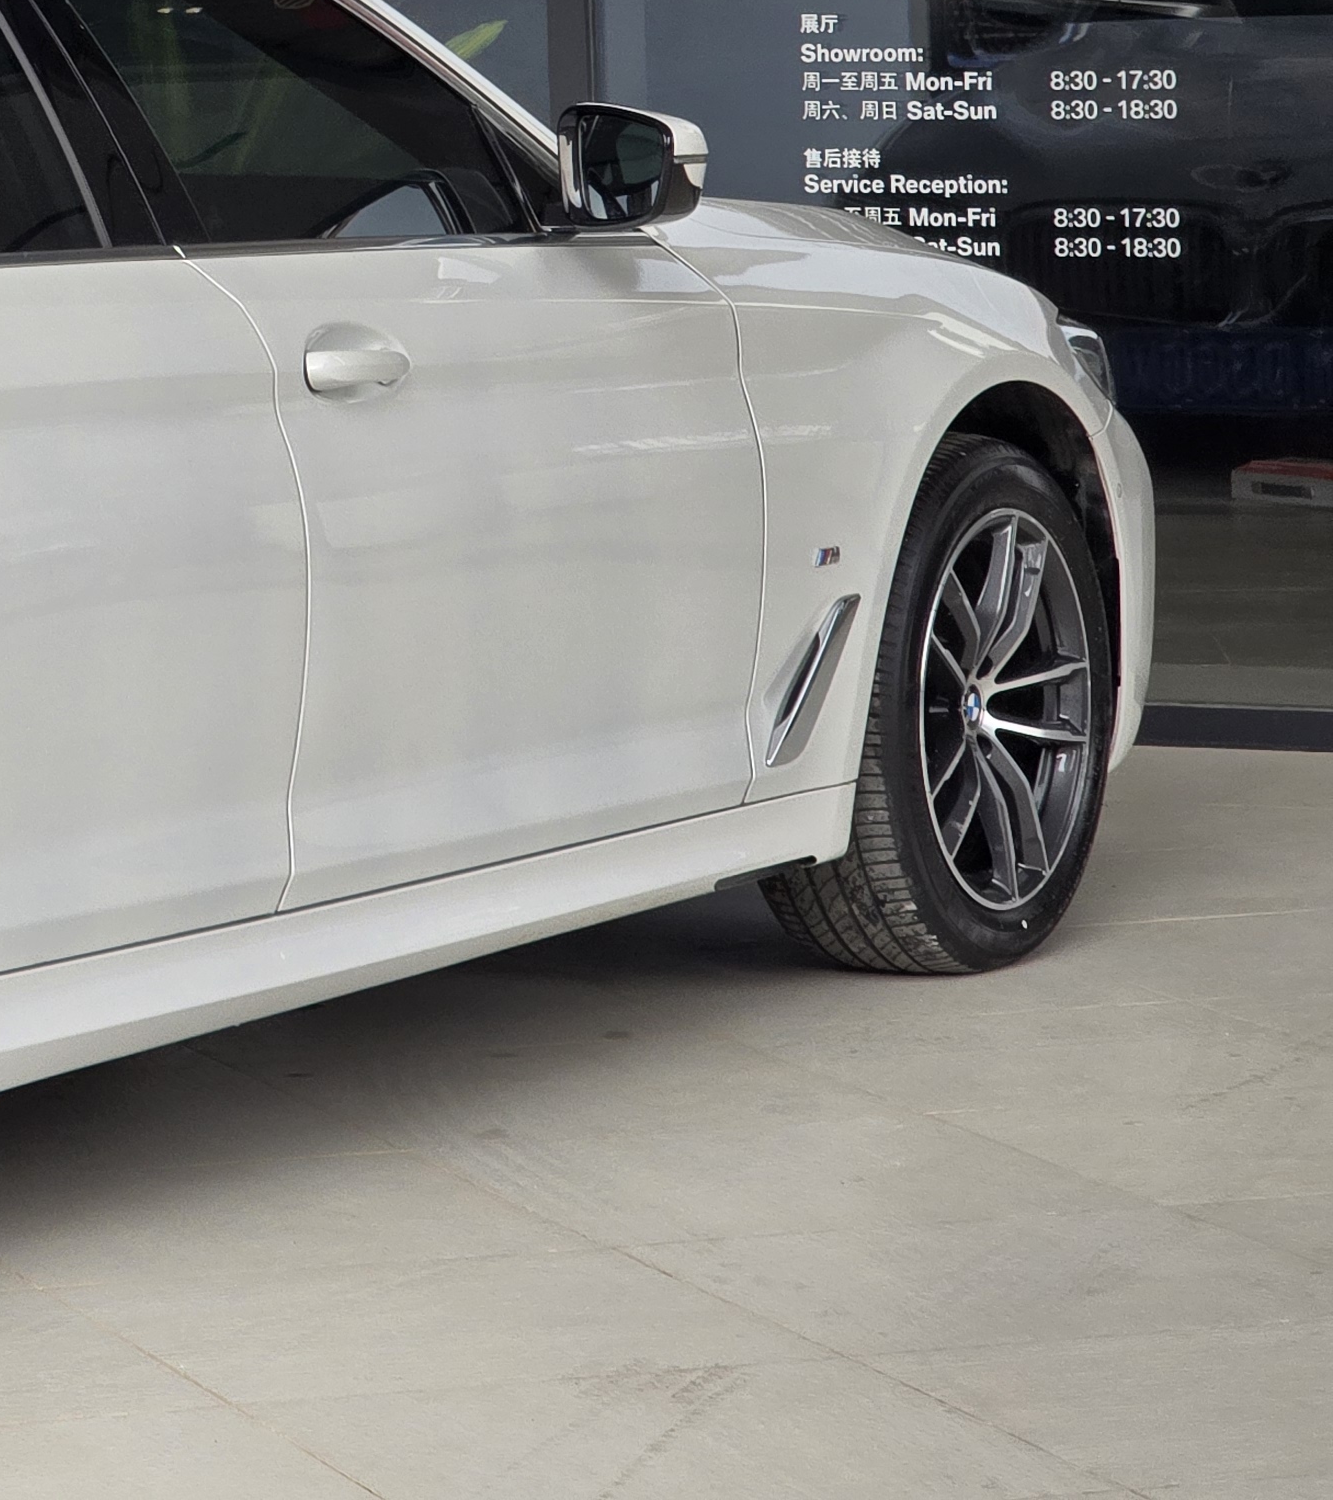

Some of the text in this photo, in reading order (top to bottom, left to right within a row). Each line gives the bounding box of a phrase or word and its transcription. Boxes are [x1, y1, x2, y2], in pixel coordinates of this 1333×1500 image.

[799, 13, 839, 34] 展厅
[800, 43, 924, 64] Showroom:
[801, 71, 899, 92] 周一至周五
[905, 71, 993, 92] Mon-Fri
[1050, 70, 1098, 91] 8:30
[1116, 69, 1177, 90] 17:30
[906, 100, 997, 121] Sat-Sun
[1050, 99, 1098, 120] 8:30
[1117, 99, 1178, 120] 18:30
[803, 147, 881, 169] 售后接待
[804, 173, 1008, 198] Service Reception:
[908, 207, 996, 227] Mon-Fri
[1053, 207, 1101, 228] 8:30
[1120, 207, 1180, 228] 17:30
[1054, 237, 1102, 258] 8:30
[1121, 237, 1181, 258] 18:30
